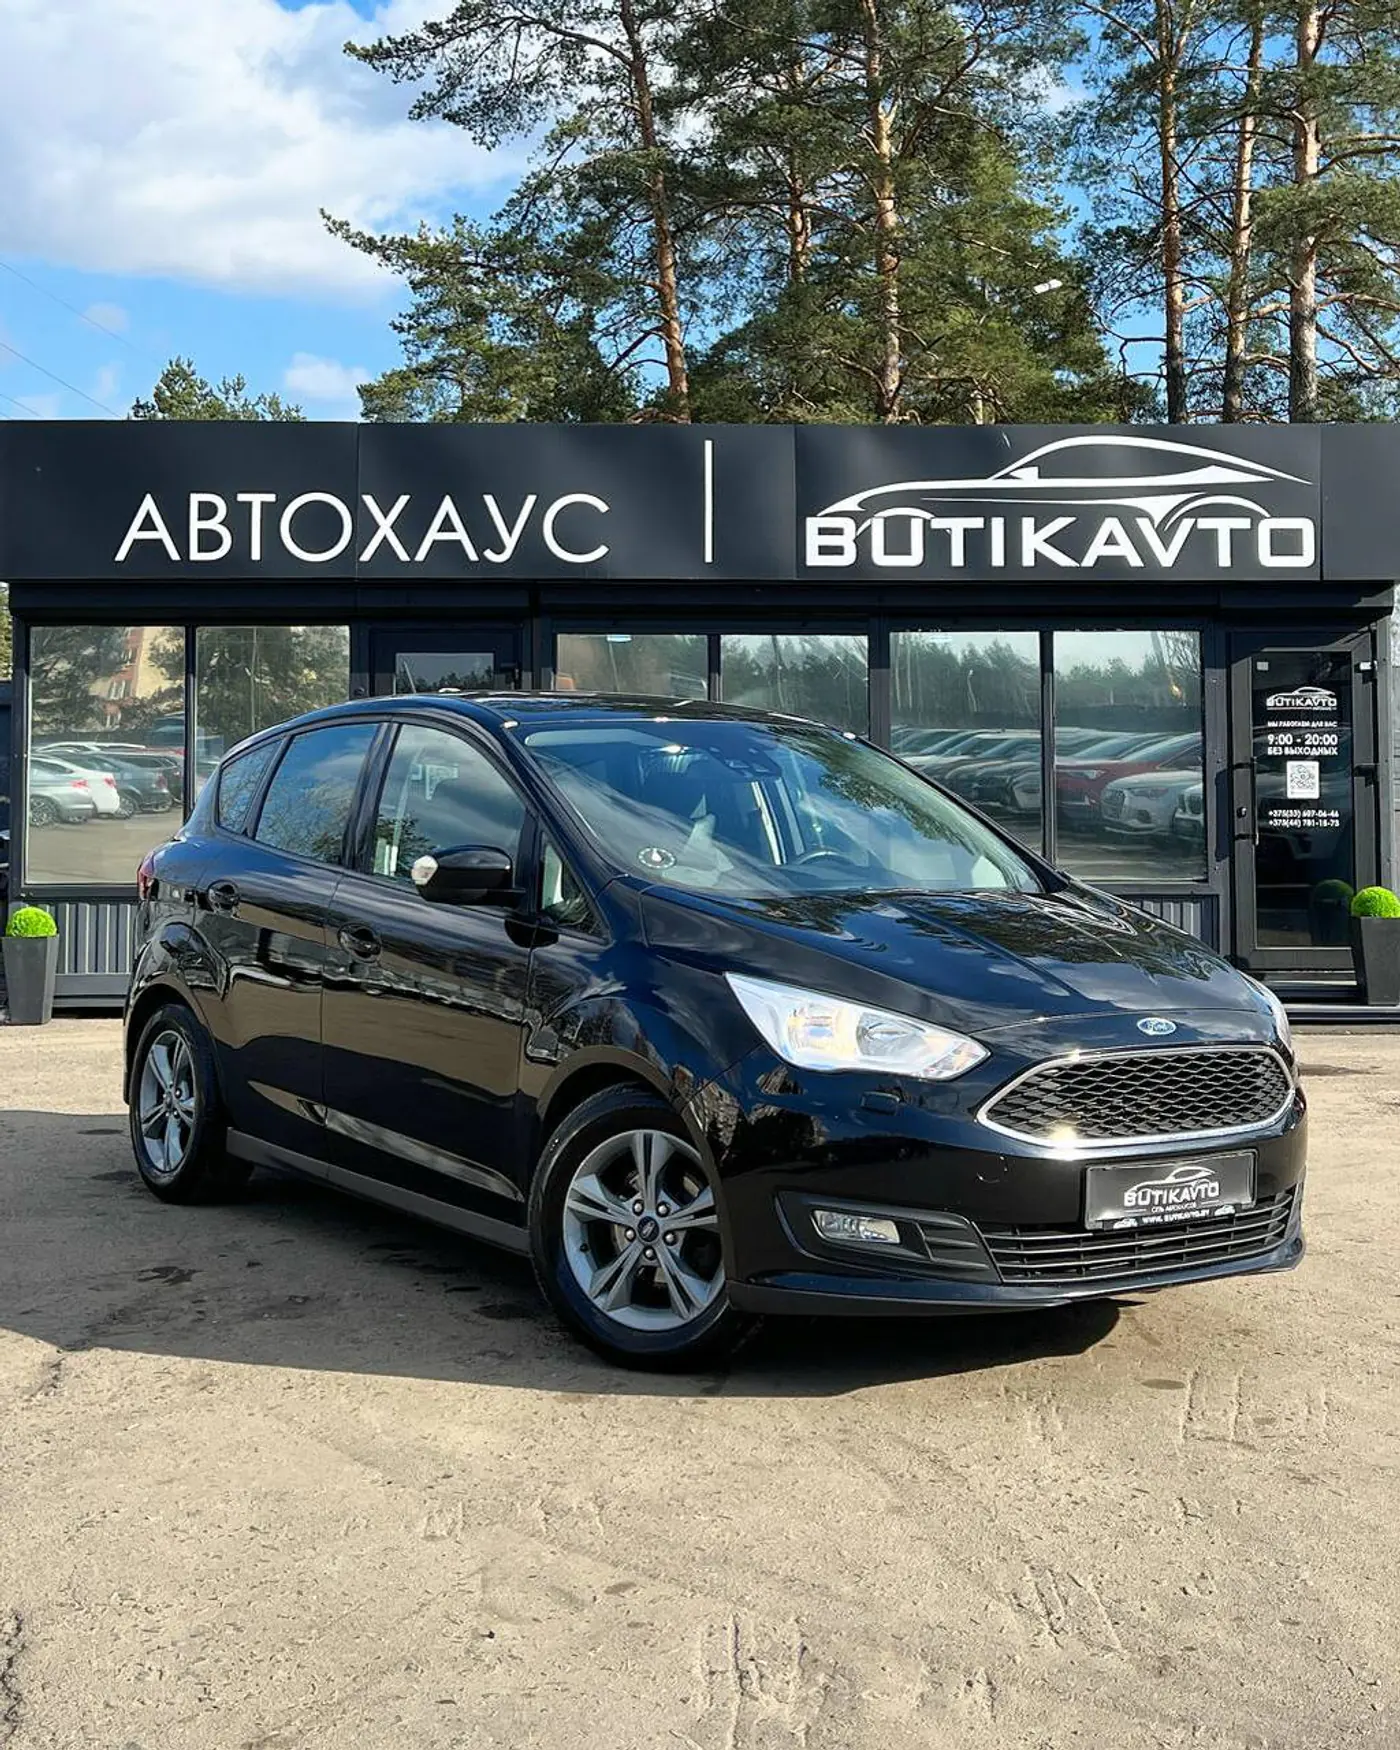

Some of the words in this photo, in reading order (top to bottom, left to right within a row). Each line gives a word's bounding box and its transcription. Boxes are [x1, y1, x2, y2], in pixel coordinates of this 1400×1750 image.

[115, 491, 611, 563] АВТОХАУС
[805, 516, 1316, 567] BUTIKAVTO
[1266, 697, 1338, 707] BUTIKAVTO
[1267, 733, 1293, 745] 9:00
[1304, 733, 1338, 745] 20:00
[1267, 746, 1283, 756] БЕЗ
[1284, 746, 1338, 756] ВЫХОДНЫХ
[1124, 1181, 1220, 1207] BUTIKAVTO
